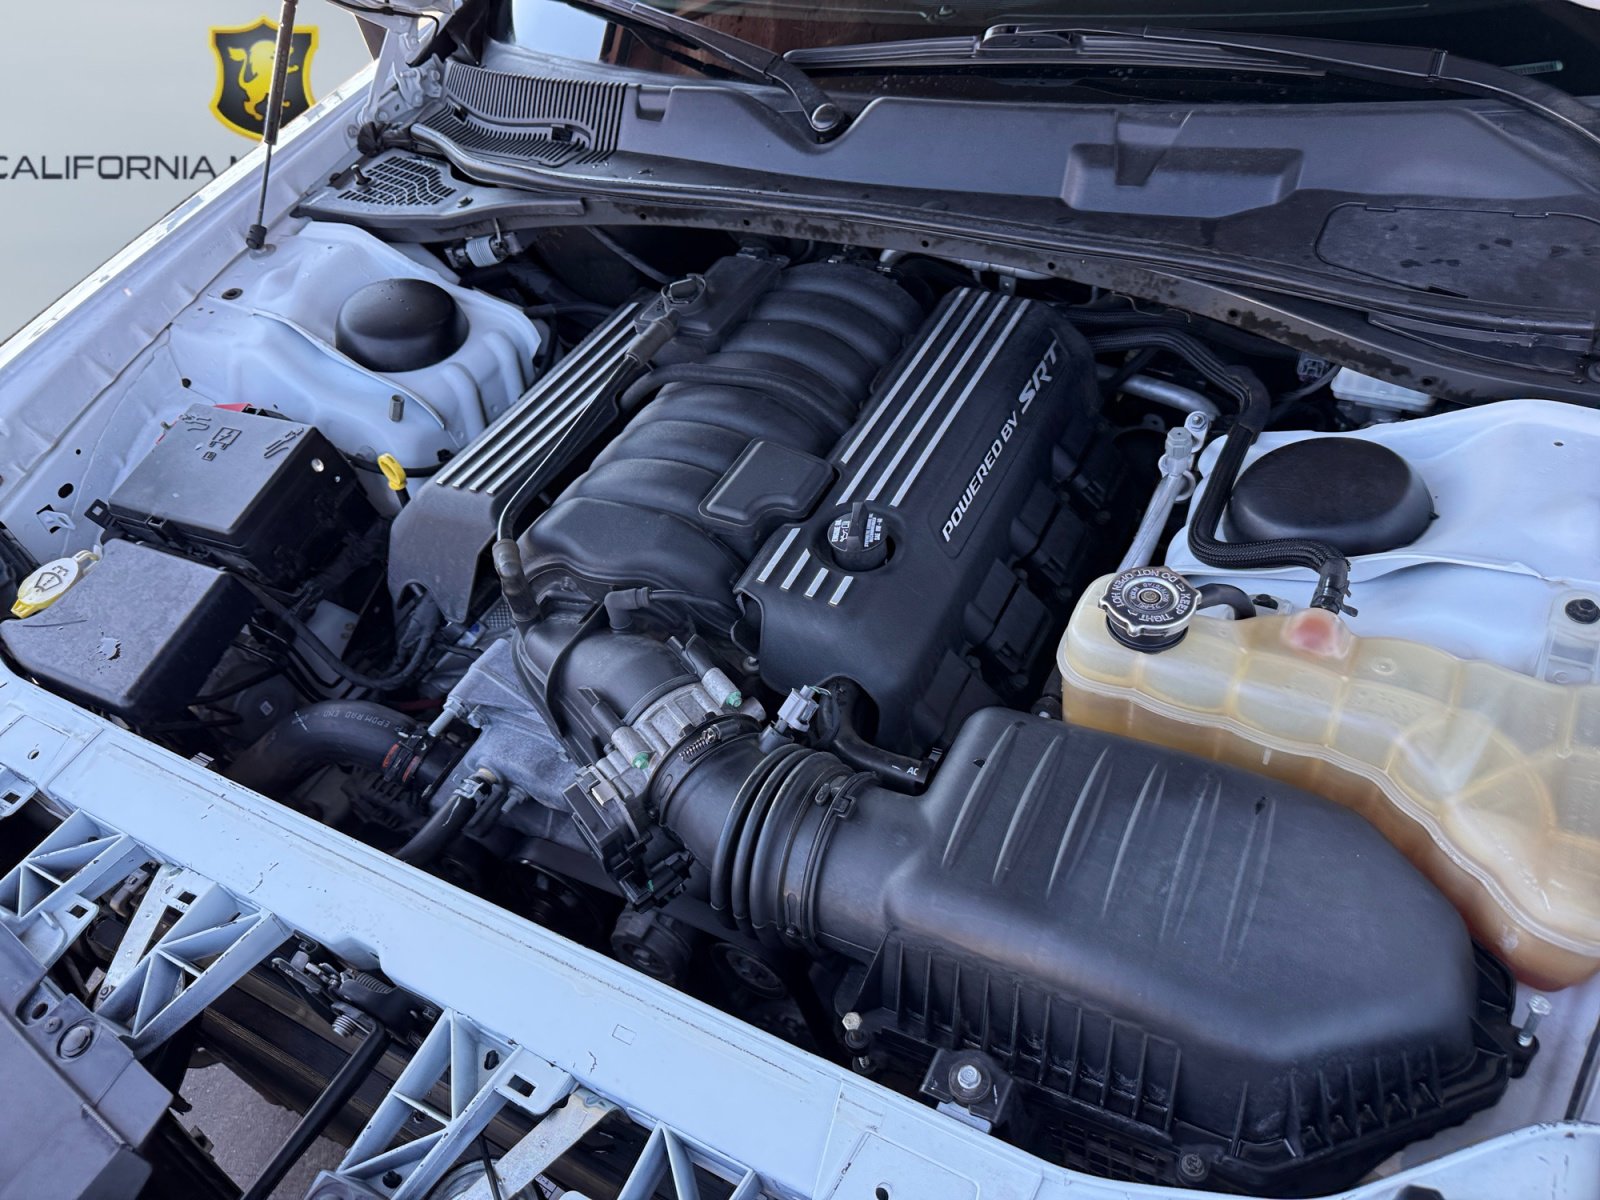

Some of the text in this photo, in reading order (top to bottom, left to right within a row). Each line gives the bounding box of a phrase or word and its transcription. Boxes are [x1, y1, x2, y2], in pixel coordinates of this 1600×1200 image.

[941, 339, 1060, 543] POWERED BY SRT
[1137, 569, 1160, 577] NOT
[1161, 572, 1178, 582] DO
[1112, 572, 1134, 591] OPEN
[1111, 592, 1125, 608] HOT
[1138, 593, 1192, 623] KEEP TIGHT
[344, 710, 364, 721] RAD
